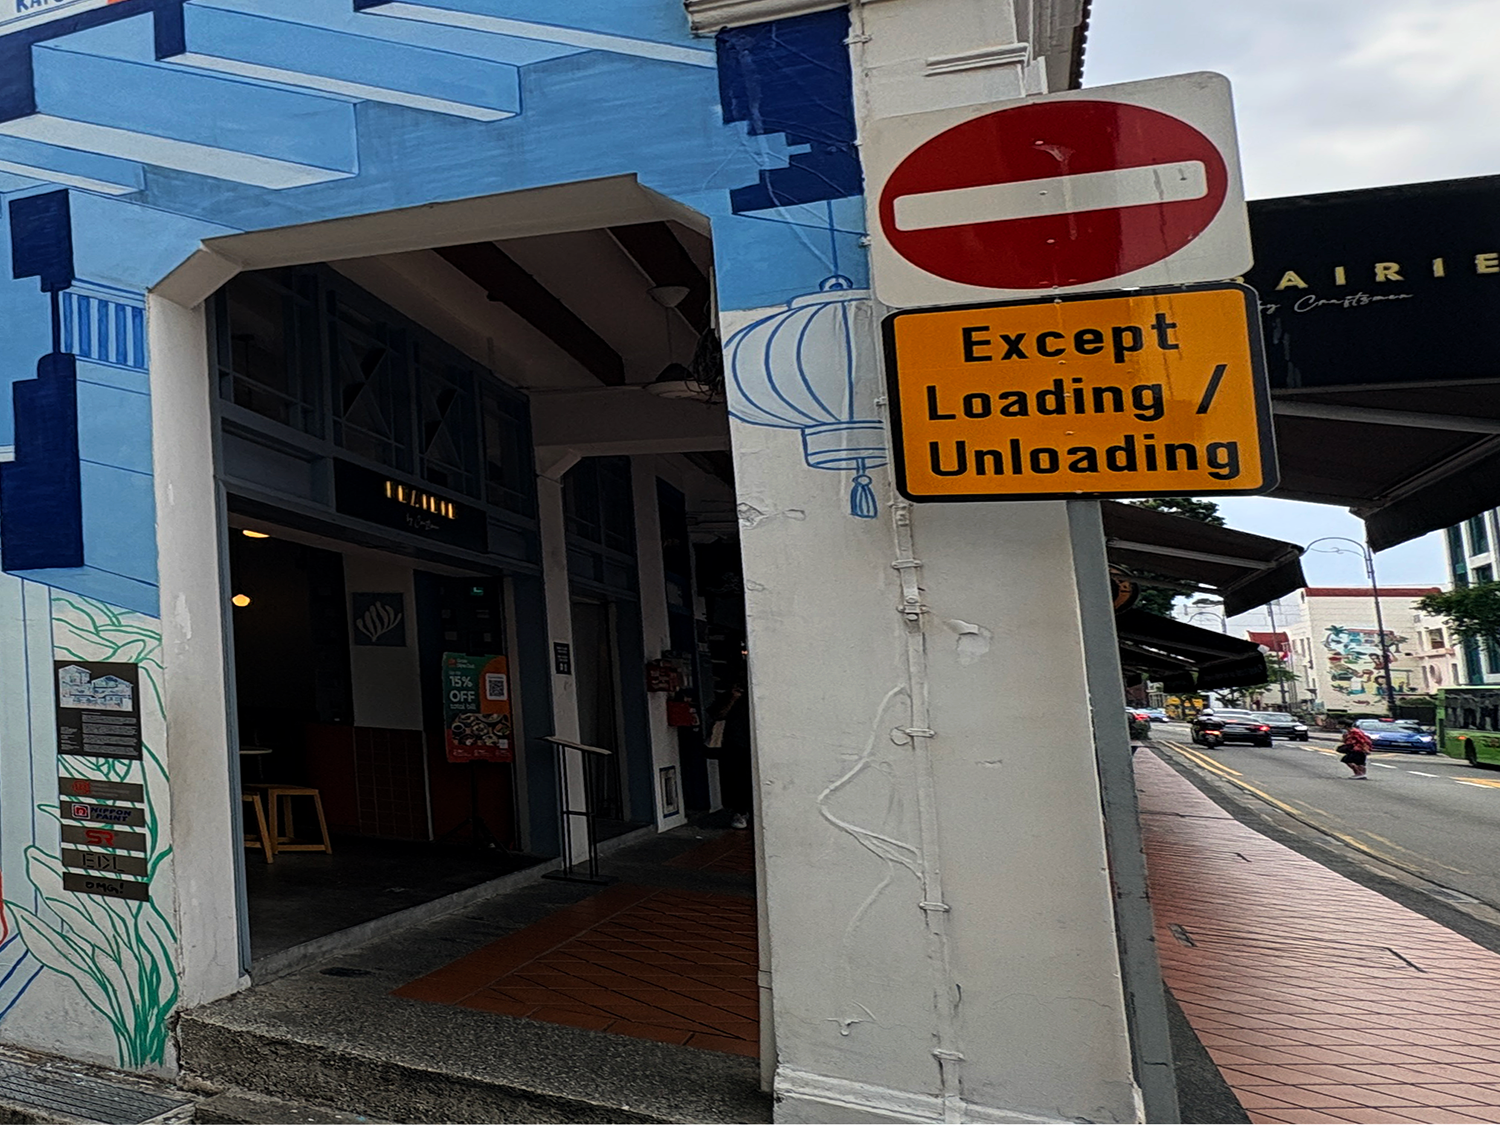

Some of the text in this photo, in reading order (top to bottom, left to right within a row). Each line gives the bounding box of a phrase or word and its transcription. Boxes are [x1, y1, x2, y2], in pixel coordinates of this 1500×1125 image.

[1236, 252, 1500, 291] AIRIE
[961, 313, 1180, 364] Except
[926, 363, 1229, 422] Loading /
[928, 433, 1241, 481] Unloading
[449, 675, 473, 688] 15%
[449, 689, 476, 703] OFF
[90, 807, 132, 817] NIPPON
[96, 813, 128, 822] PAINT
